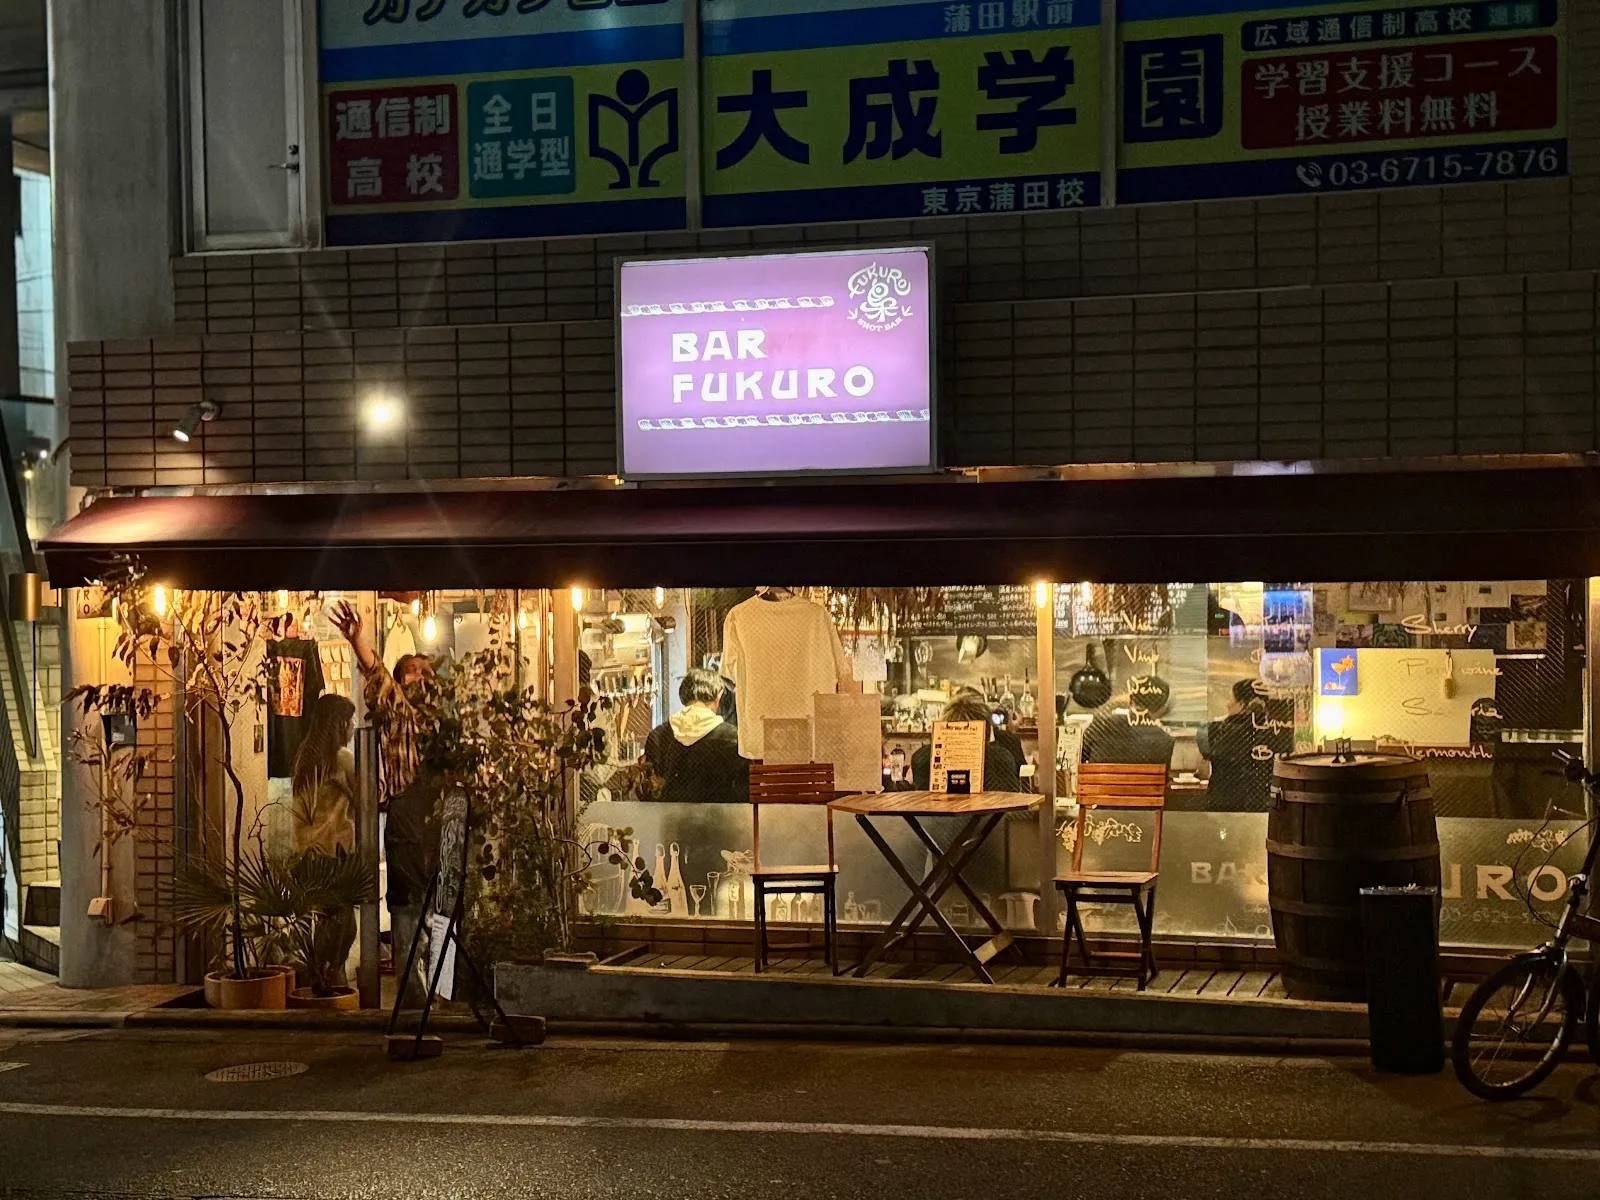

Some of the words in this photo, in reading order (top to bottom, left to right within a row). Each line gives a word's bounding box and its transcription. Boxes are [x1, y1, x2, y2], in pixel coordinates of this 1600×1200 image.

[944, 0, 1075, 32] 蒲田駅前
[1253, 8, 1473, 48] 広域通信制高校
[1254, 46, 1543, 99] 学習支援コース
[335, 94, 451, 141] 通信制
[482, 91, 557, 135] 全日
[1295, 90, 1500, 142] 授業料無料
[347, 153, 444, 198] 高校
[473, 136, 570, 181] 通学型
[1329, 147, 1559, 186] 03-6715-7876
[921, 179, 1085, 215] 東京蒲田校
[672, 328, 768, 363] BAR
[672, 365, 875, 404] FUKURO
[1401, 614, 1478, 643] Sherry
[1126, 675, 1163, 695] Wein
